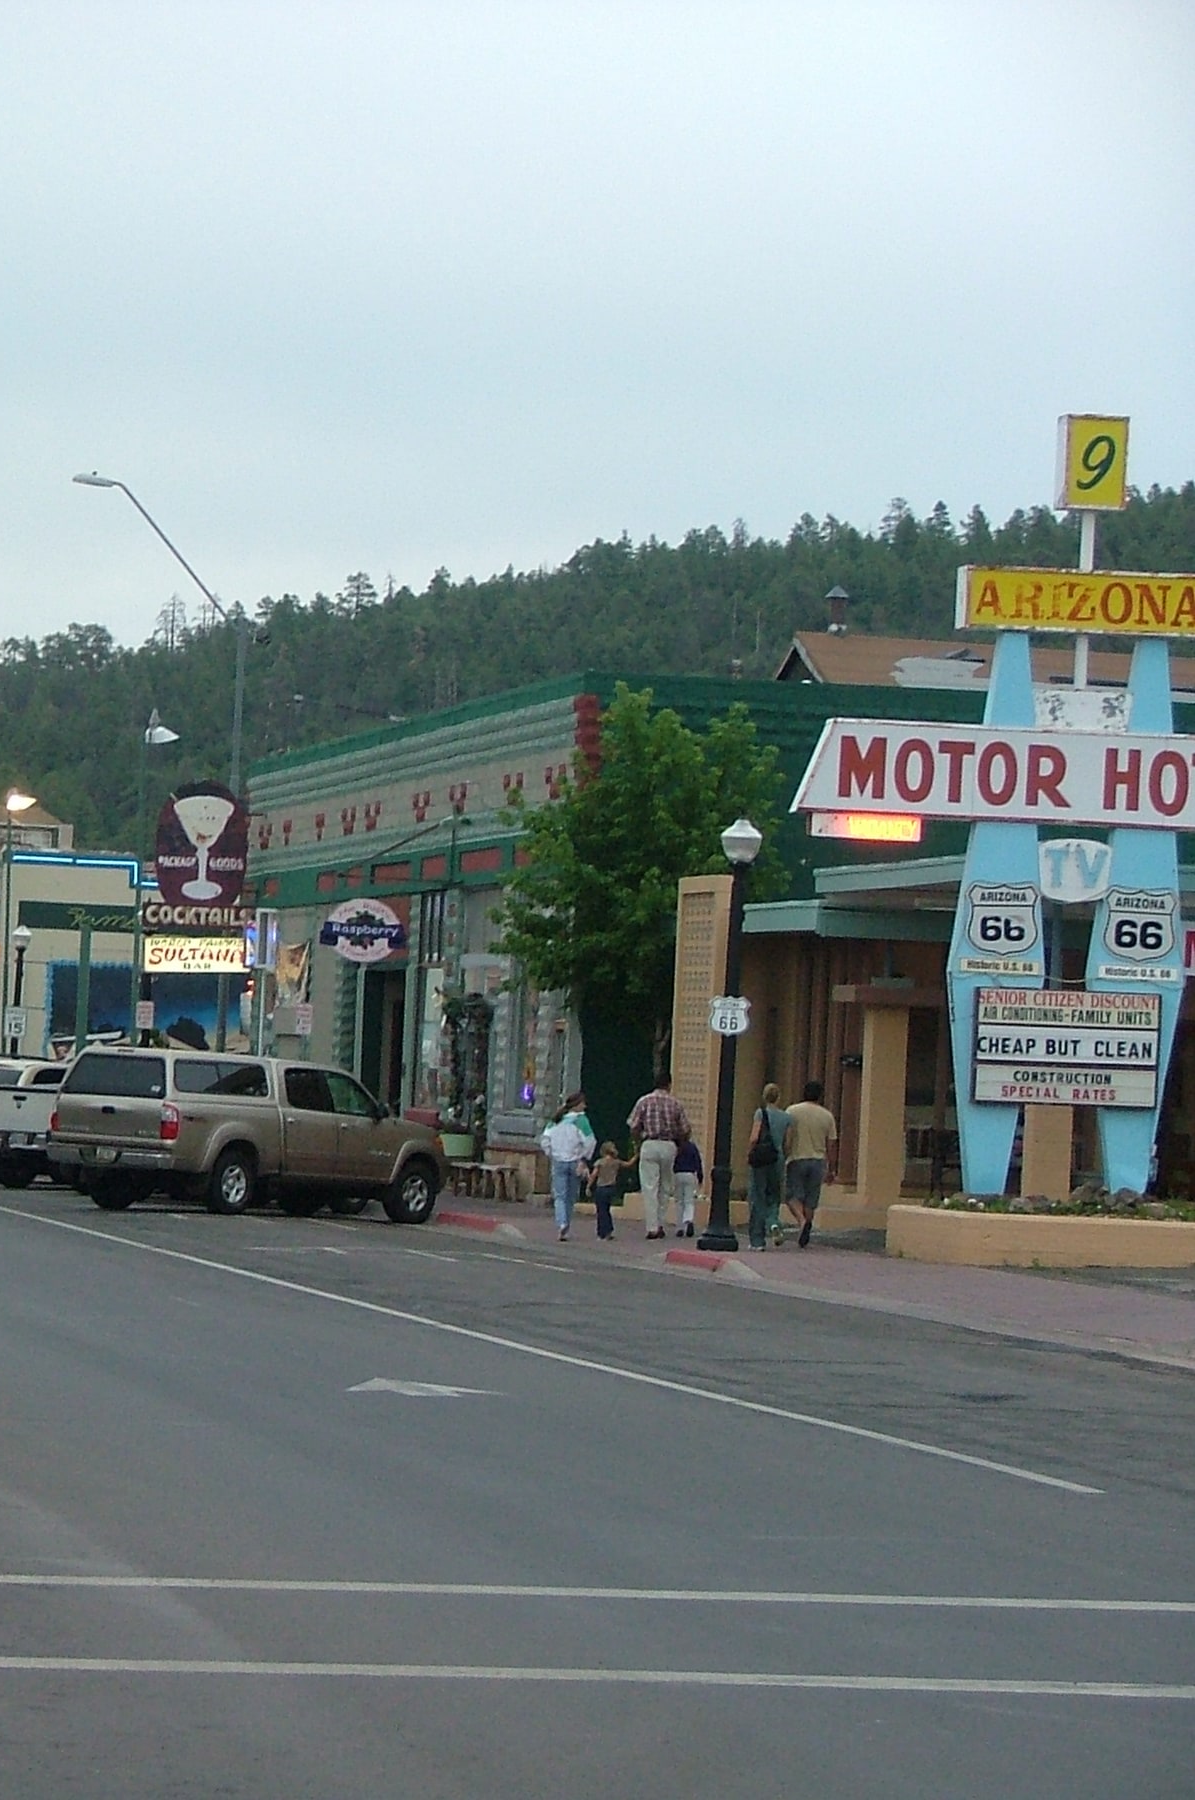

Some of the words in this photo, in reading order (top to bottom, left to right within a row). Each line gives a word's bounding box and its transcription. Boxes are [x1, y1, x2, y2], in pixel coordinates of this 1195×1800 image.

[1076, 435, 1115, 490] 9
[975, 579, 1195, 628] ARIZONA
[837, 735, 1072, 808] MOTOR
[1103, 747, 1195, 817] HO
[209, 857, 244, 871] GOODS
[1045, 848, 1109, 889] TV
[979, 891, 1027, 903] ARIZONA
[1114, 897, 1166, 910] ARIZONA
[145, 904, 254, 926] COCKTAILS
[331, 923, 400, 938] Raspberry
[1114, 919, 1163, 950] 66
[148, 947, 244, 965] SULTANA
[183, 962, 212, 970] BAR
[966, 959, 1001, 970] Historic
[1105, 967, 1138, 978] Historic
[979, 991, 1027, 1006] SENIOR
[1033, 992, 1084, 1008] CITIZEN
[1091, 994, 1157, 1011] DISCOUNT
[719, 1016, 738, 1030] 66
[982, 1006, 998, 1019] AIR
[1117, 1012, 1152, 1026] UNITS
[8, 1023, 22, 1034] 15
[977, 1036, 1036, 1054] CHEAP
[1046, 1039, 1081, 1057] BUT
[1094, 1040, 1153, 1059] CLEAN
[1013, 1070, 1112, 1085] CONSTRUCTION
[1001, 1085, 1060, 1099] SPECIAL
[1072, 1088, 1116, 1101] RATES
